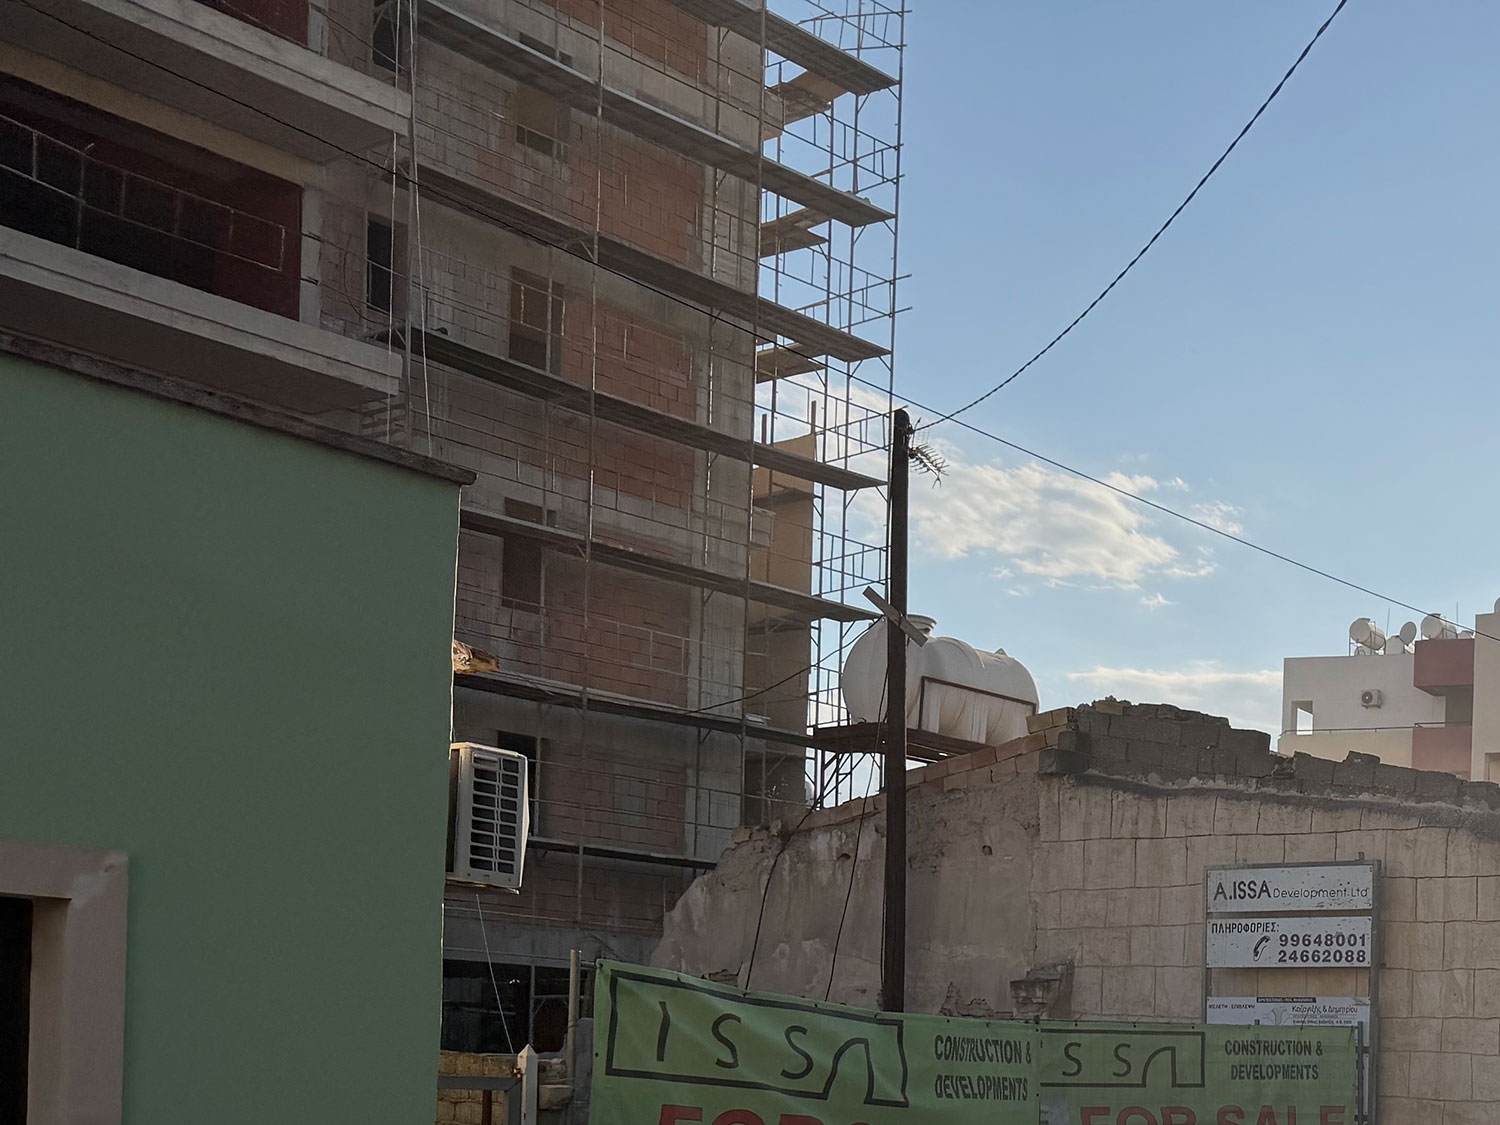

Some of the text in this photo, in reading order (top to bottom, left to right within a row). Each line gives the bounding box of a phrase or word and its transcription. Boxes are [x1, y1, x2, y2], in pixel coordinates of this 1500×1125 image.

[1213, 880, 1271, 901] A.ISSA
[1211, 922, 1280, 934] ΠΛΗΡΟΦΟΡΙΕΣ:
[1278, 933, 1366, 947] 99648001
[1277, 950, 1367, 964] 24662088
[934, 1034, 1023, 1064] CONSTRUCTION
[1224, 1040, 1323, 1056] CONSTRUCTION &
[1230, 1064, 1319, 1080] DEVELOPMENTS
[934, 1074, 1029, 1101] DEVELOPMENTS
